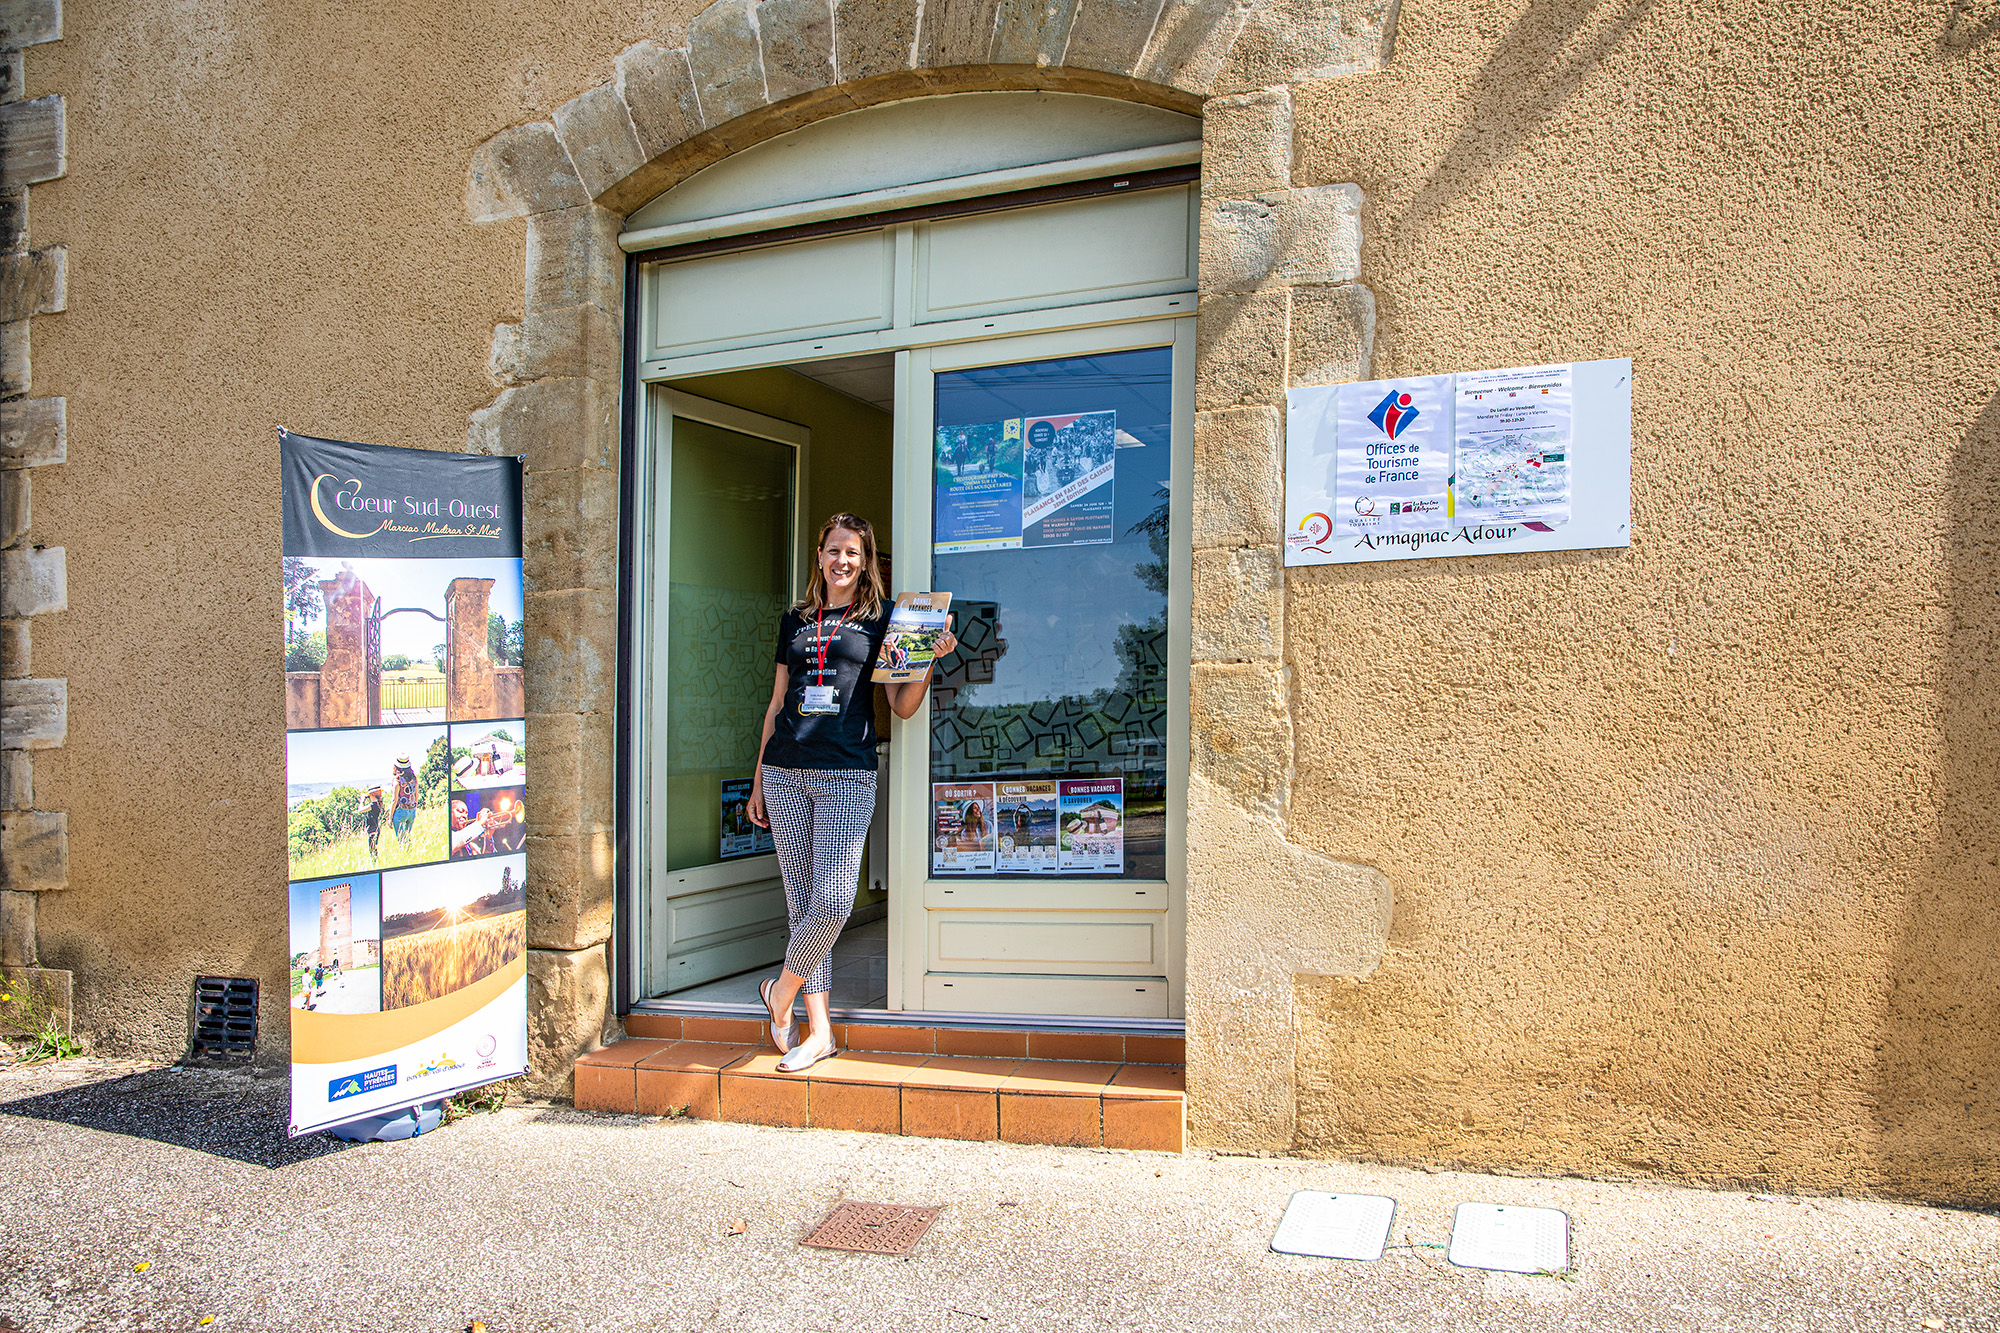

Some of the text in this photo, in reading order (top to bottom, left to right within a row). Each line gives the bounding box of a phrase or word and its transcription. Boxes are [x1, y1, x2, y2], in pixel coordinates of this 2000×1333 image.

[1464, 388, 1494, 396] Bienvenue
[1528, 382, 1562, 390] Bienvenidos
[1366, 443, 1420, 456] Offices de
[1366, 456, 1419, 469] Tourisme
[1365, 470, 1419, 484] de France
[974, 482, 1012, 490] MOUSQUETAIRES
[1023, 463, 1113, 518] PLAISANCE EN FAIT DES CAISSES
[336, 490, 501, 519] Coeur Sud-Ouest
[380, 519, 420, 533] Marciac
[420, 521, 463, 535] Madiran
[476, 524, 503, 536] Mont
[1354, 524, 1517, 551] Armagnac Adour
[945, 789, 952, 798] OÙ
[954, 789, 972, 798] SORTIR
[1026, 785, 1051, 793] VACANCES
[1070, 785, 1115, 794] BONNES VACANCES
[1003, 795, 1027, 803] DÉCOUVRIR
[1068, 796, 1092, 804] SAVOURER
